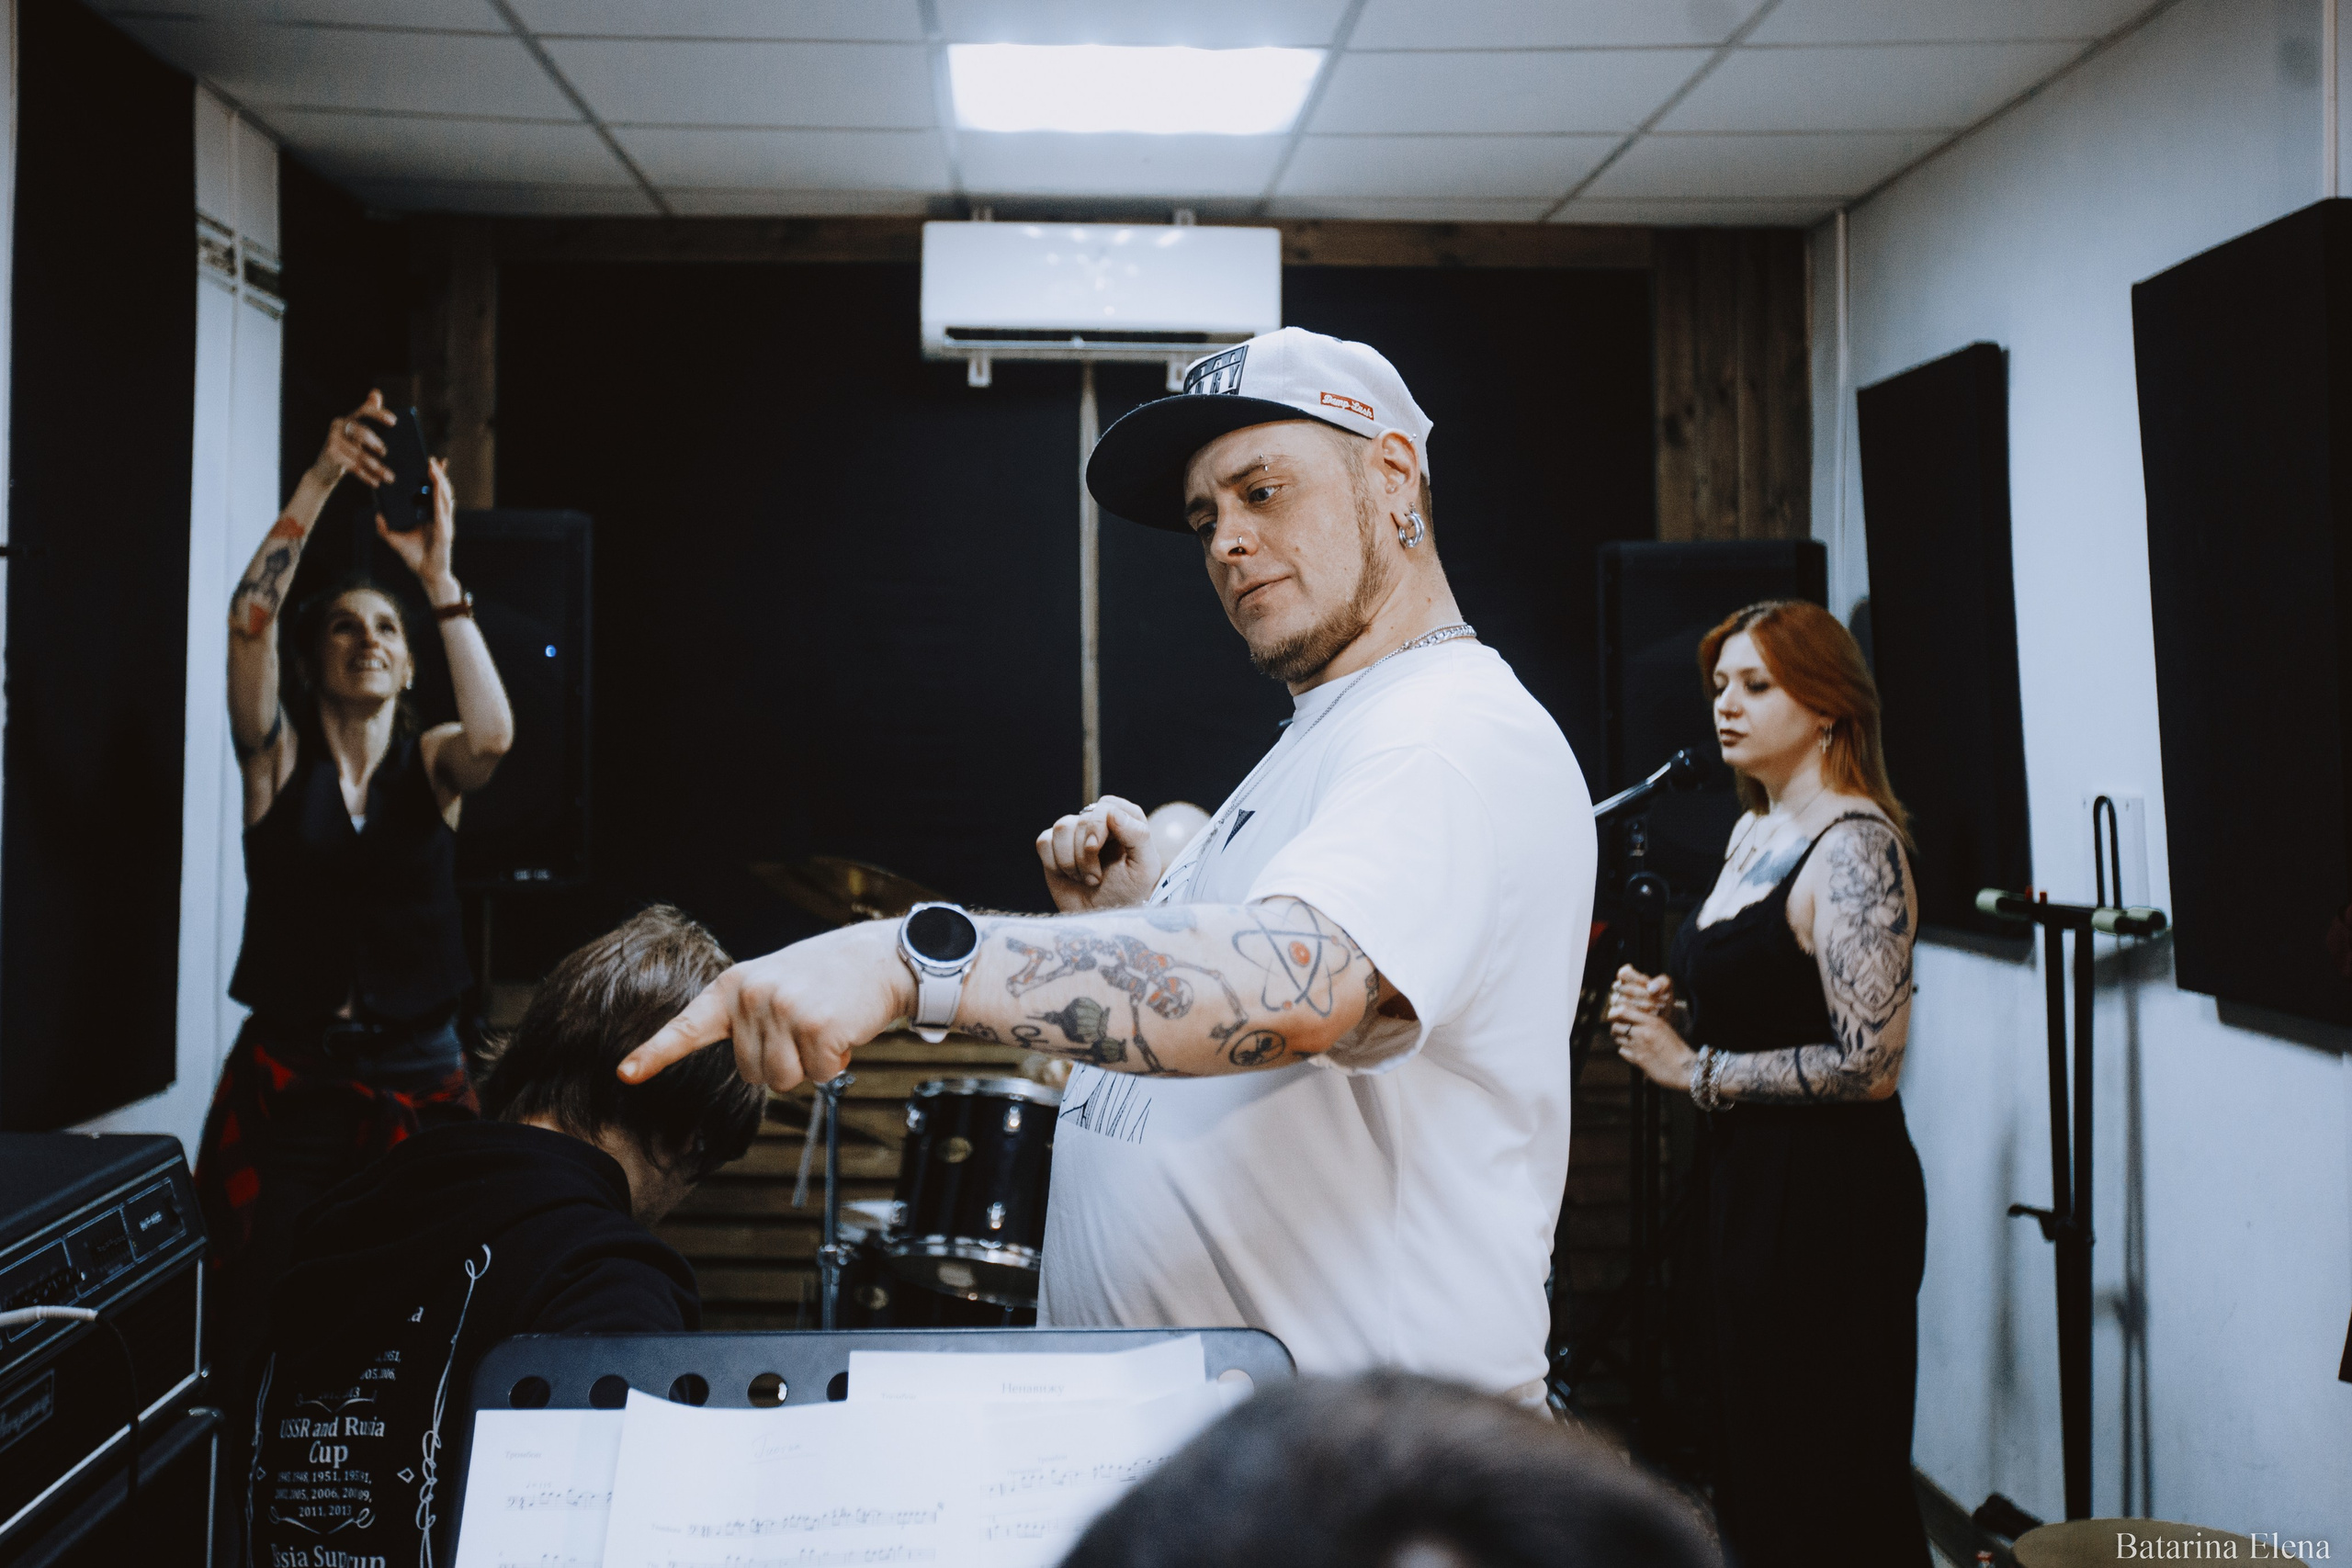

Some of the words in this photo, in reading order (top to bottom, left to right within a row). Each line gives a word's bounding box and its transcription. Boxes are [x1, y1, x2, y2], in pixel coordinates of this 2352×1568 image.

[312, 1416, 339, 1437] and
[309, 1439, 349, 1469] Cup
[312, 1471, 342, 1483] 1951,
[311, 1487, 340, 1500] 2006,
[299, 1505, 326, 1517] 2011,
